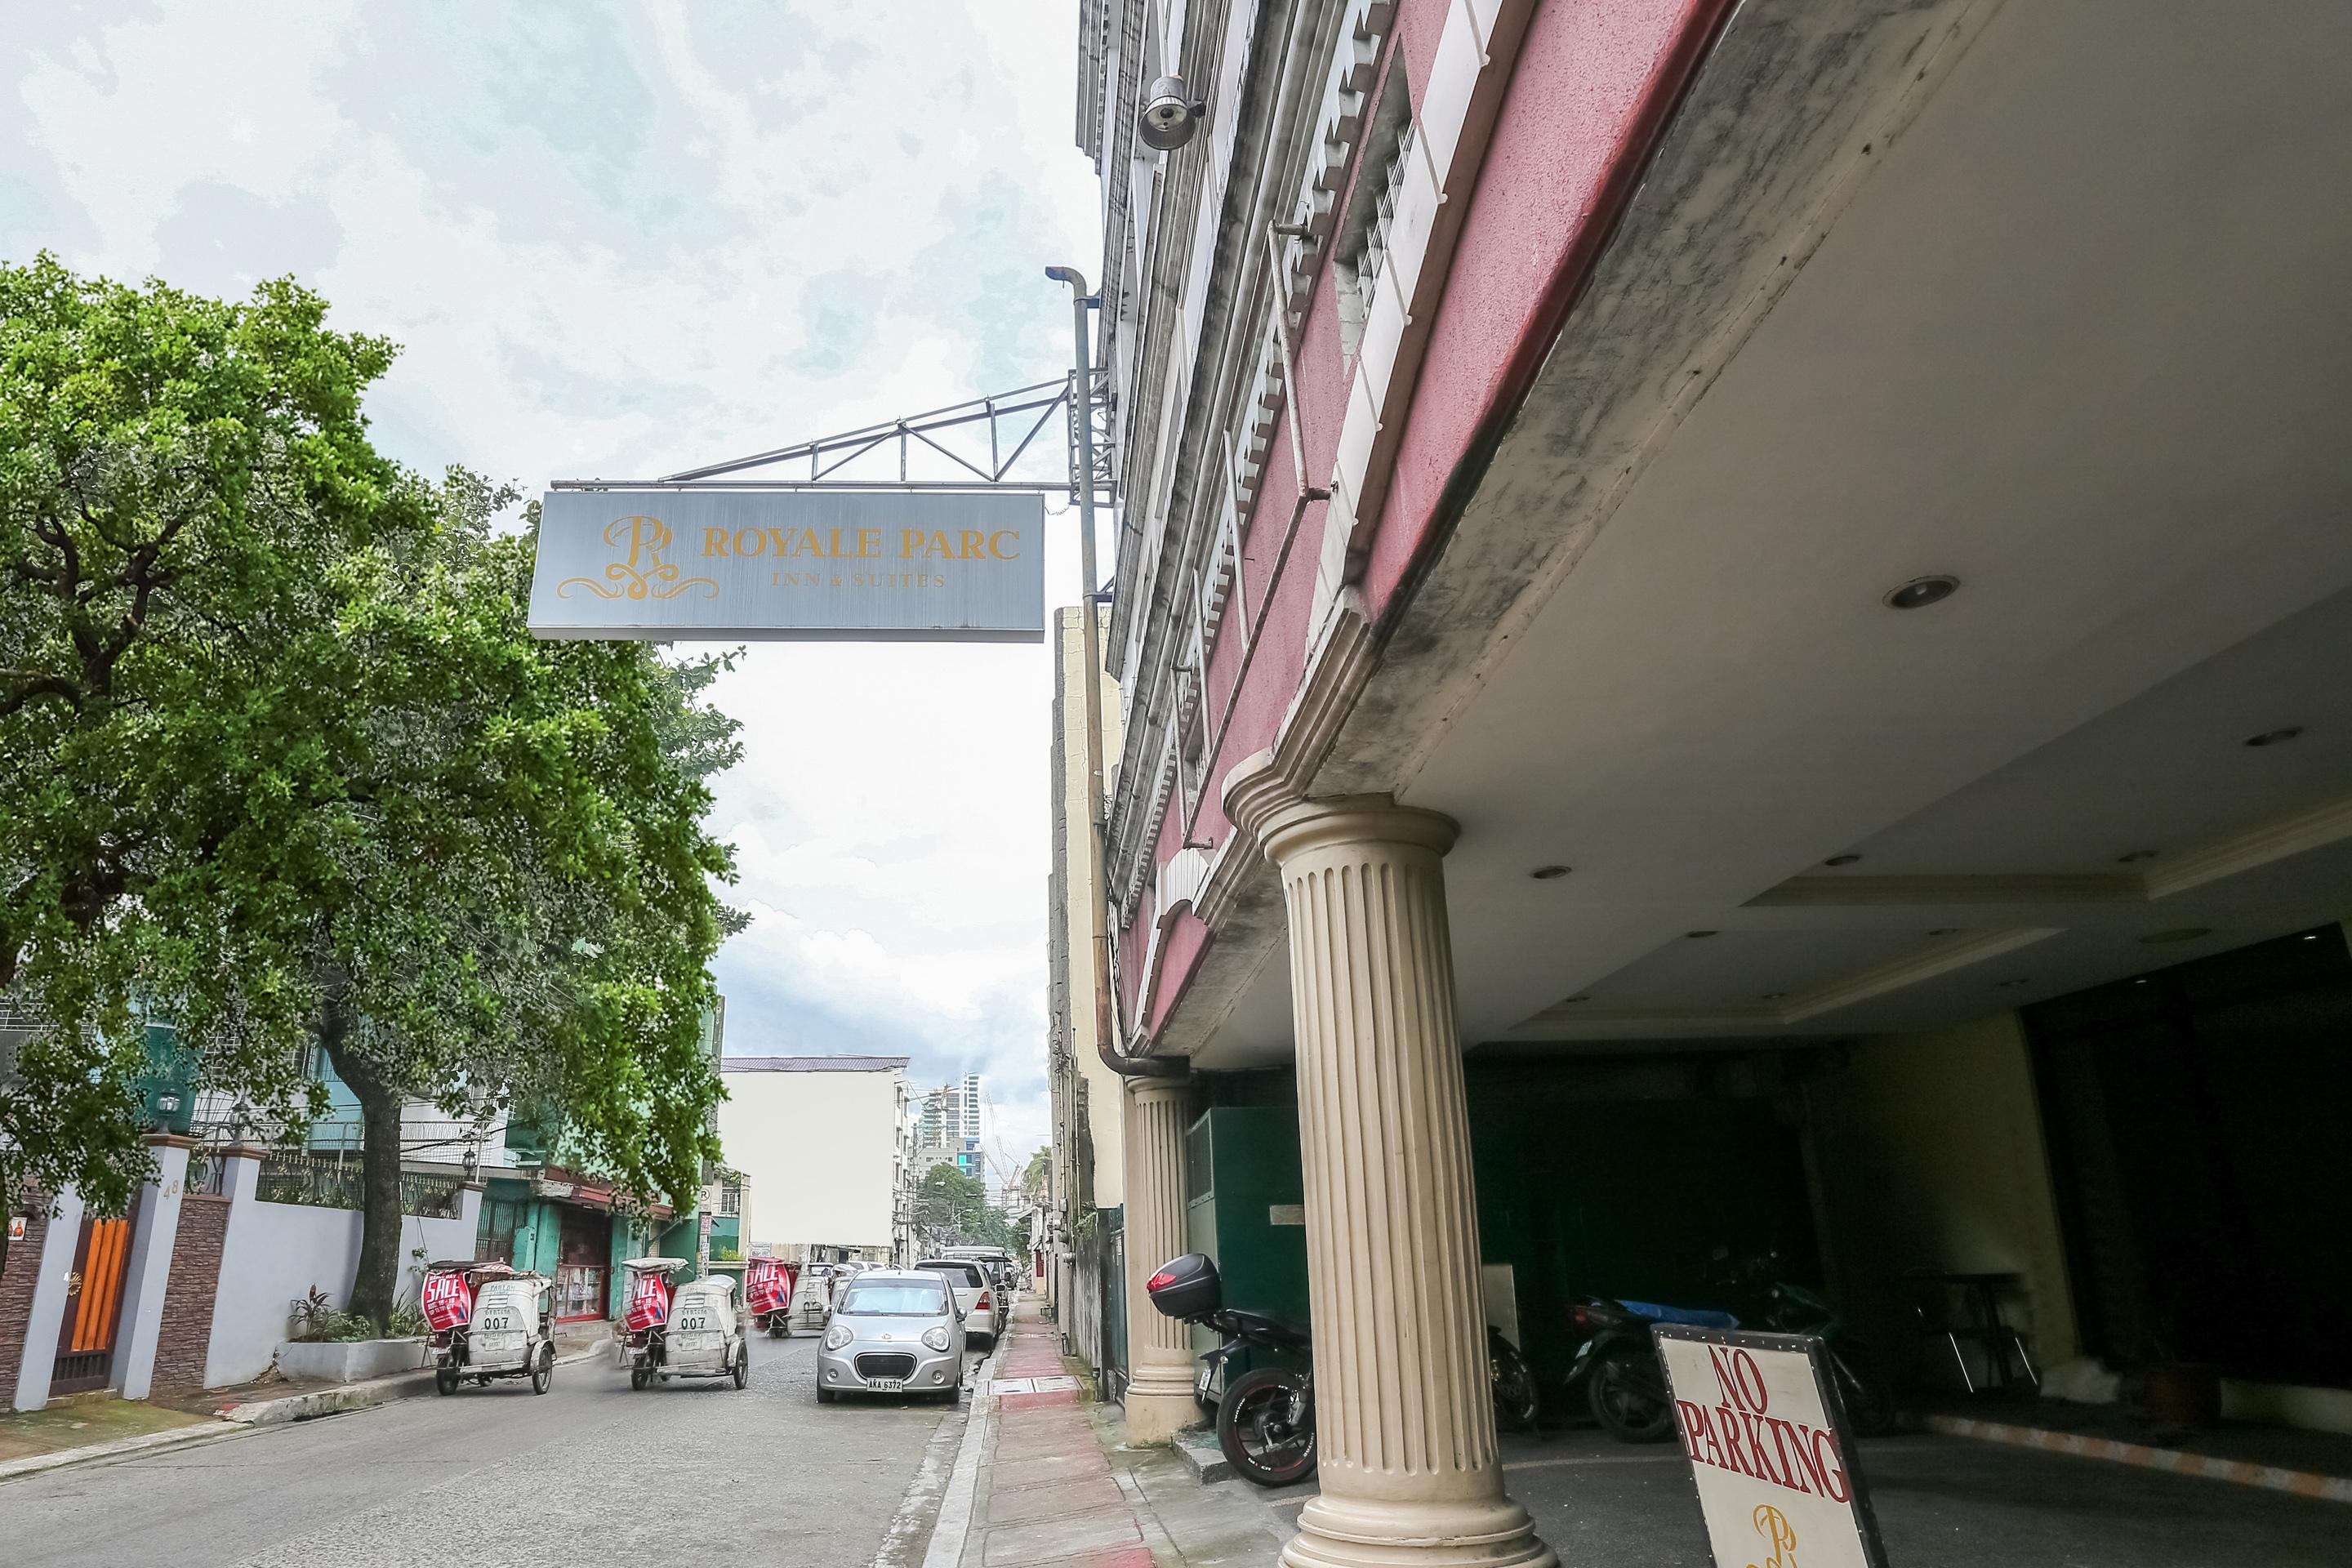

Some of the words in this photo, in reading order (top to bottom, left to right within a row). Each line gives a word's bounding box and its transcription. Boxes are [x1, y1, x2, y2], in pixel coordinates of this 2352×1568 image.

[700, 527, 882, 558] ROYALE
[899, 528, 1020, 559] PARC
[771, 572, 821, 587] INN
[830, 574, 842, 587] &
[853, 573, 945, 588] SUITES
[163, 1179, 179, 1200] 48
[427, 1279, 459, 1303] SALE
[484, 1317, 509, 1330] 007
[681, 1317, 706, 1330] 007
[884, 1381, 901, 1389] 6372
[1708, 1344, 1769, 1414] NO
[1676, 1400, 1850, 1503] PARKING
